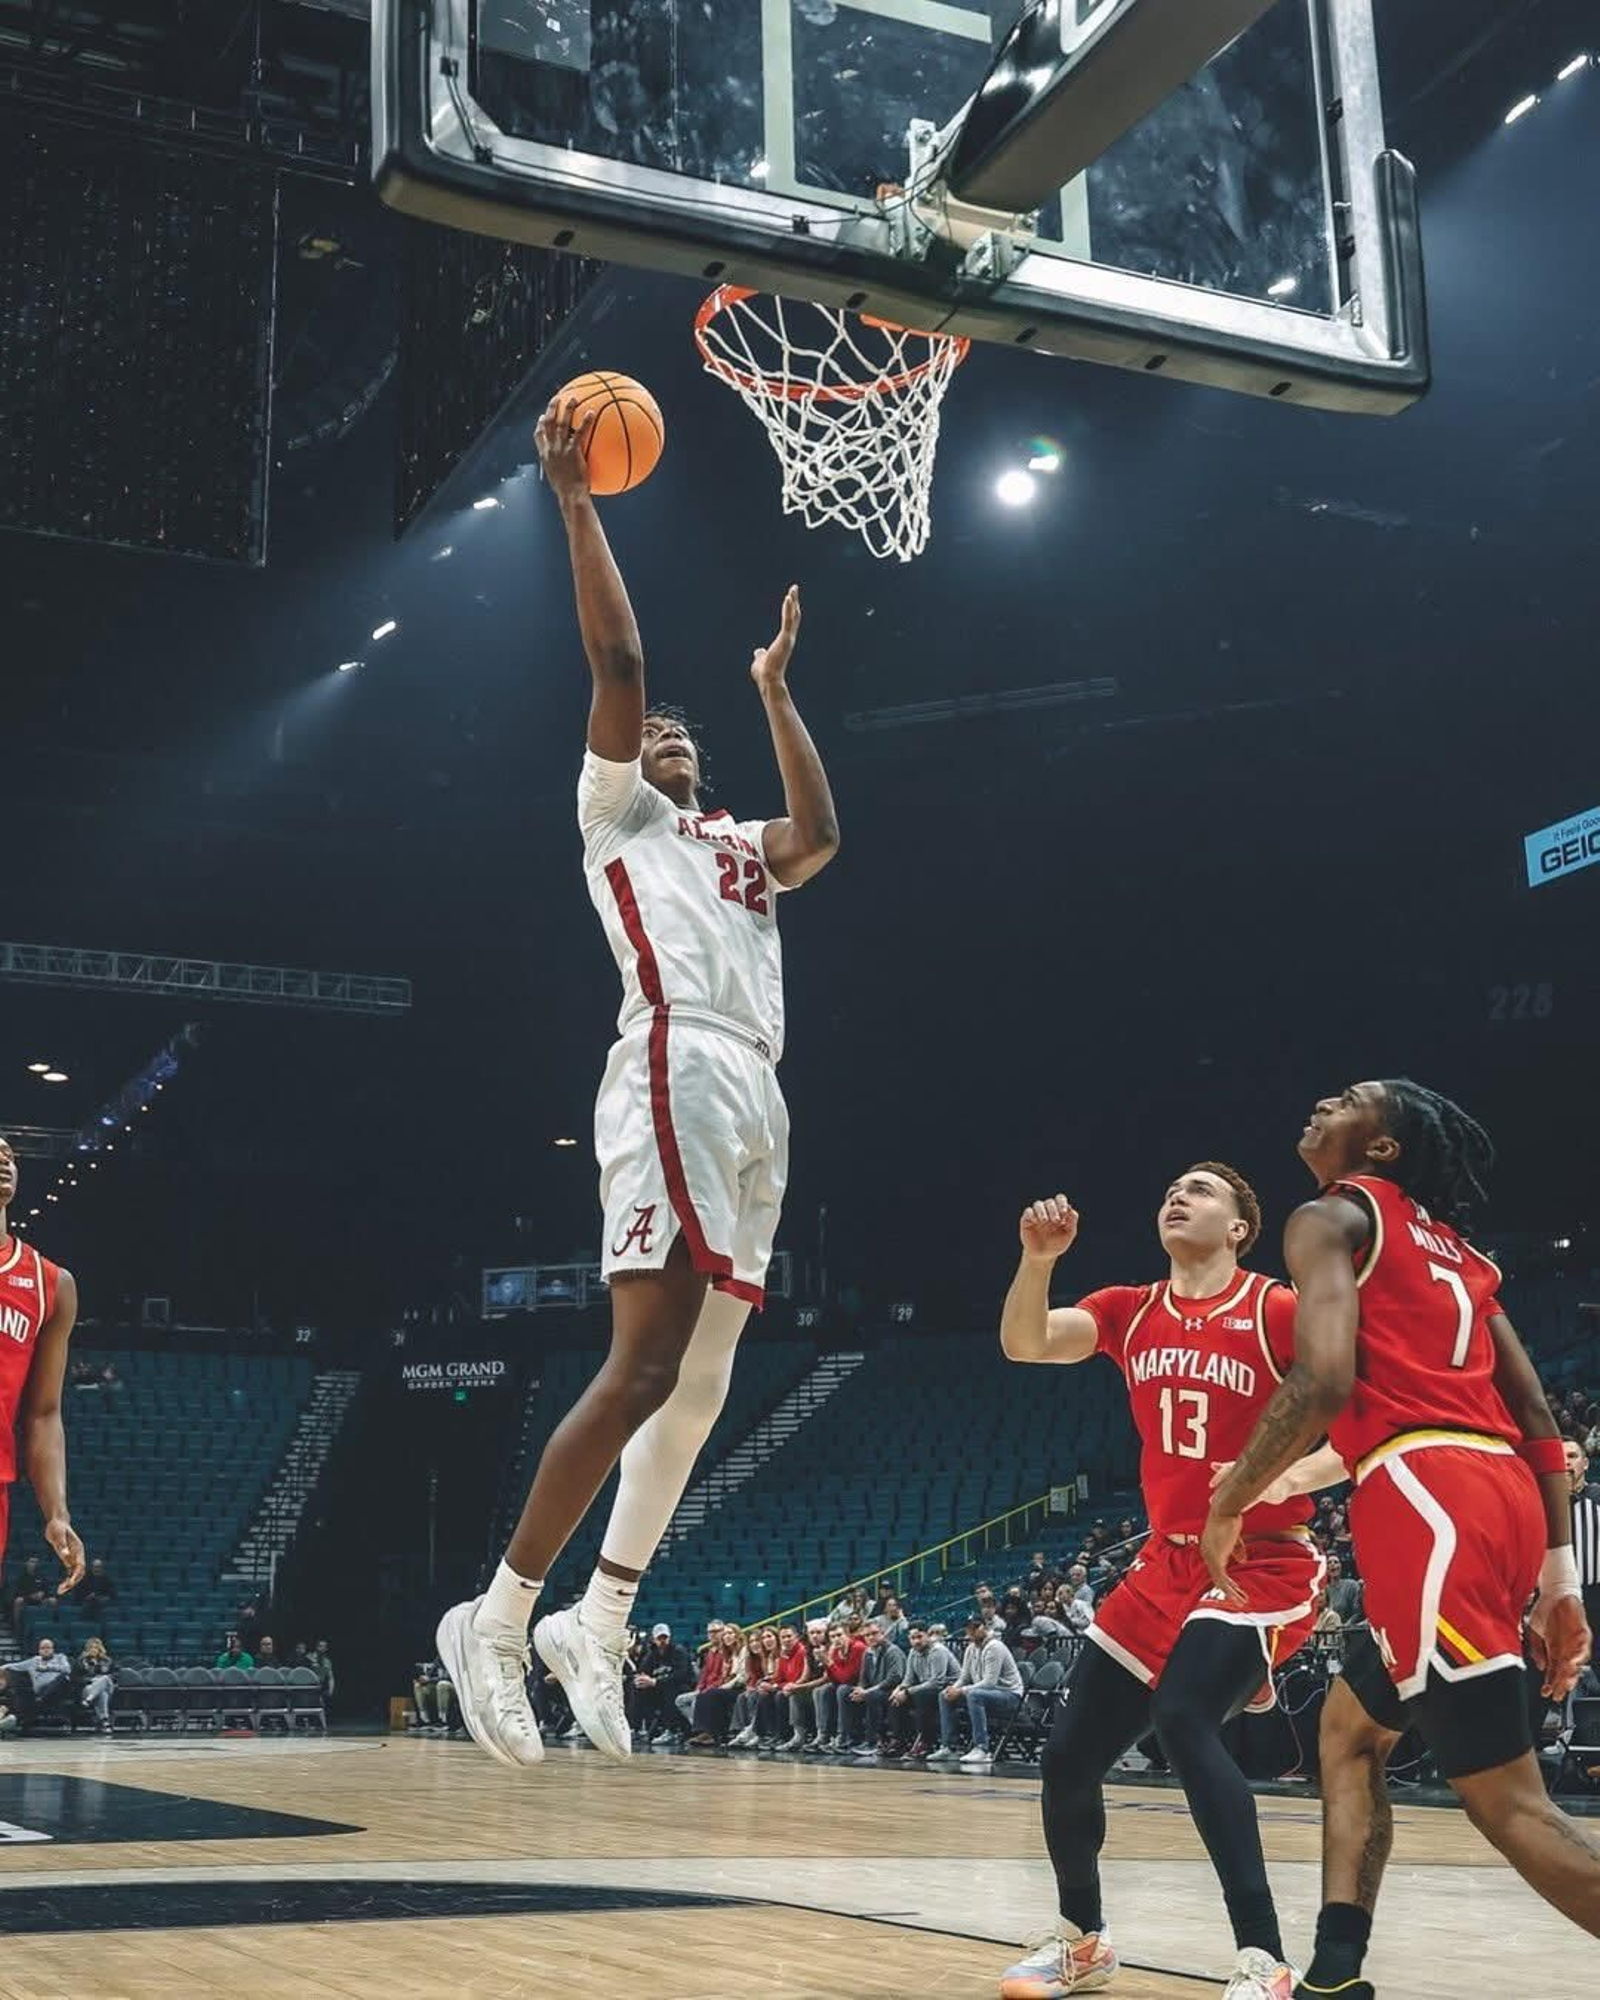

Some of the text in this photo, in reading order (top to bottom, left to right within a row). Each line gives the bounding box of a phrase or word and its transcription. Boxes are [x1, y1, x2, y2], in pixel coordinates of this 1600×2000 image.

[715, 853, 768, 917] 22
[612, 1204, 656, 1257] A
[1427, 1259, 1473, 1369] 7
[402, 1360, 507, 1379] MGM GRAND
[1131, 1347, 1256, 1398] MARYLAND
[1159, 1387, 1209, 1460] 13
